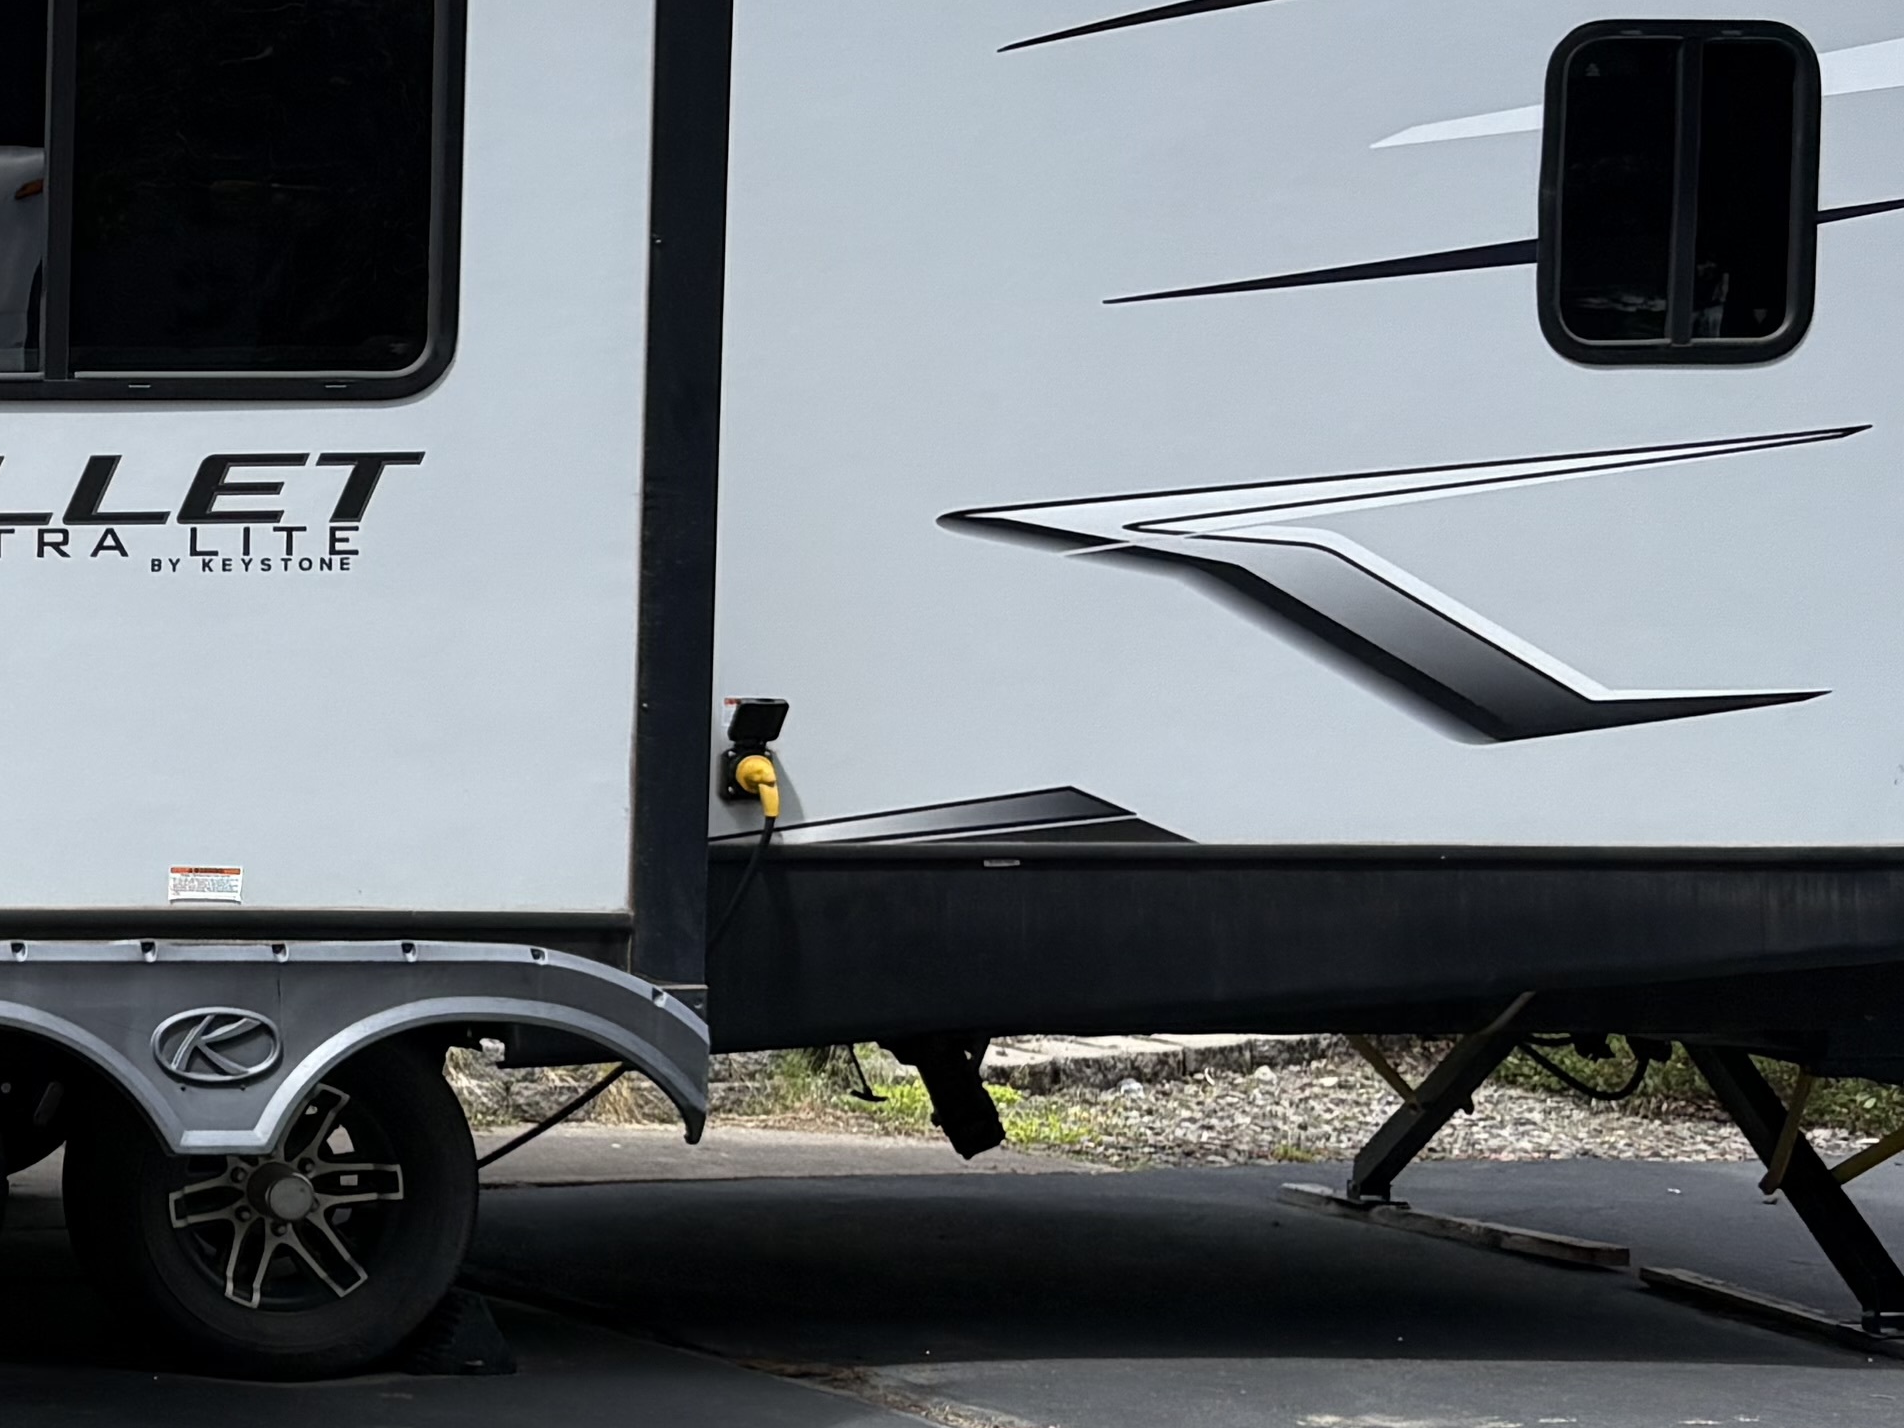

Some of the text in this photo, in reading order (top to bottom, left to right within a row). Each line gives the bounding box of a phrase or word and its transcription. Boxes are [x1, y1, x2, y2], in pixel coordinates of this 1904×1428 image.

[189, 525, 360, 557] LITE
[150, 555, 353, 573] BY KEYSTONE
